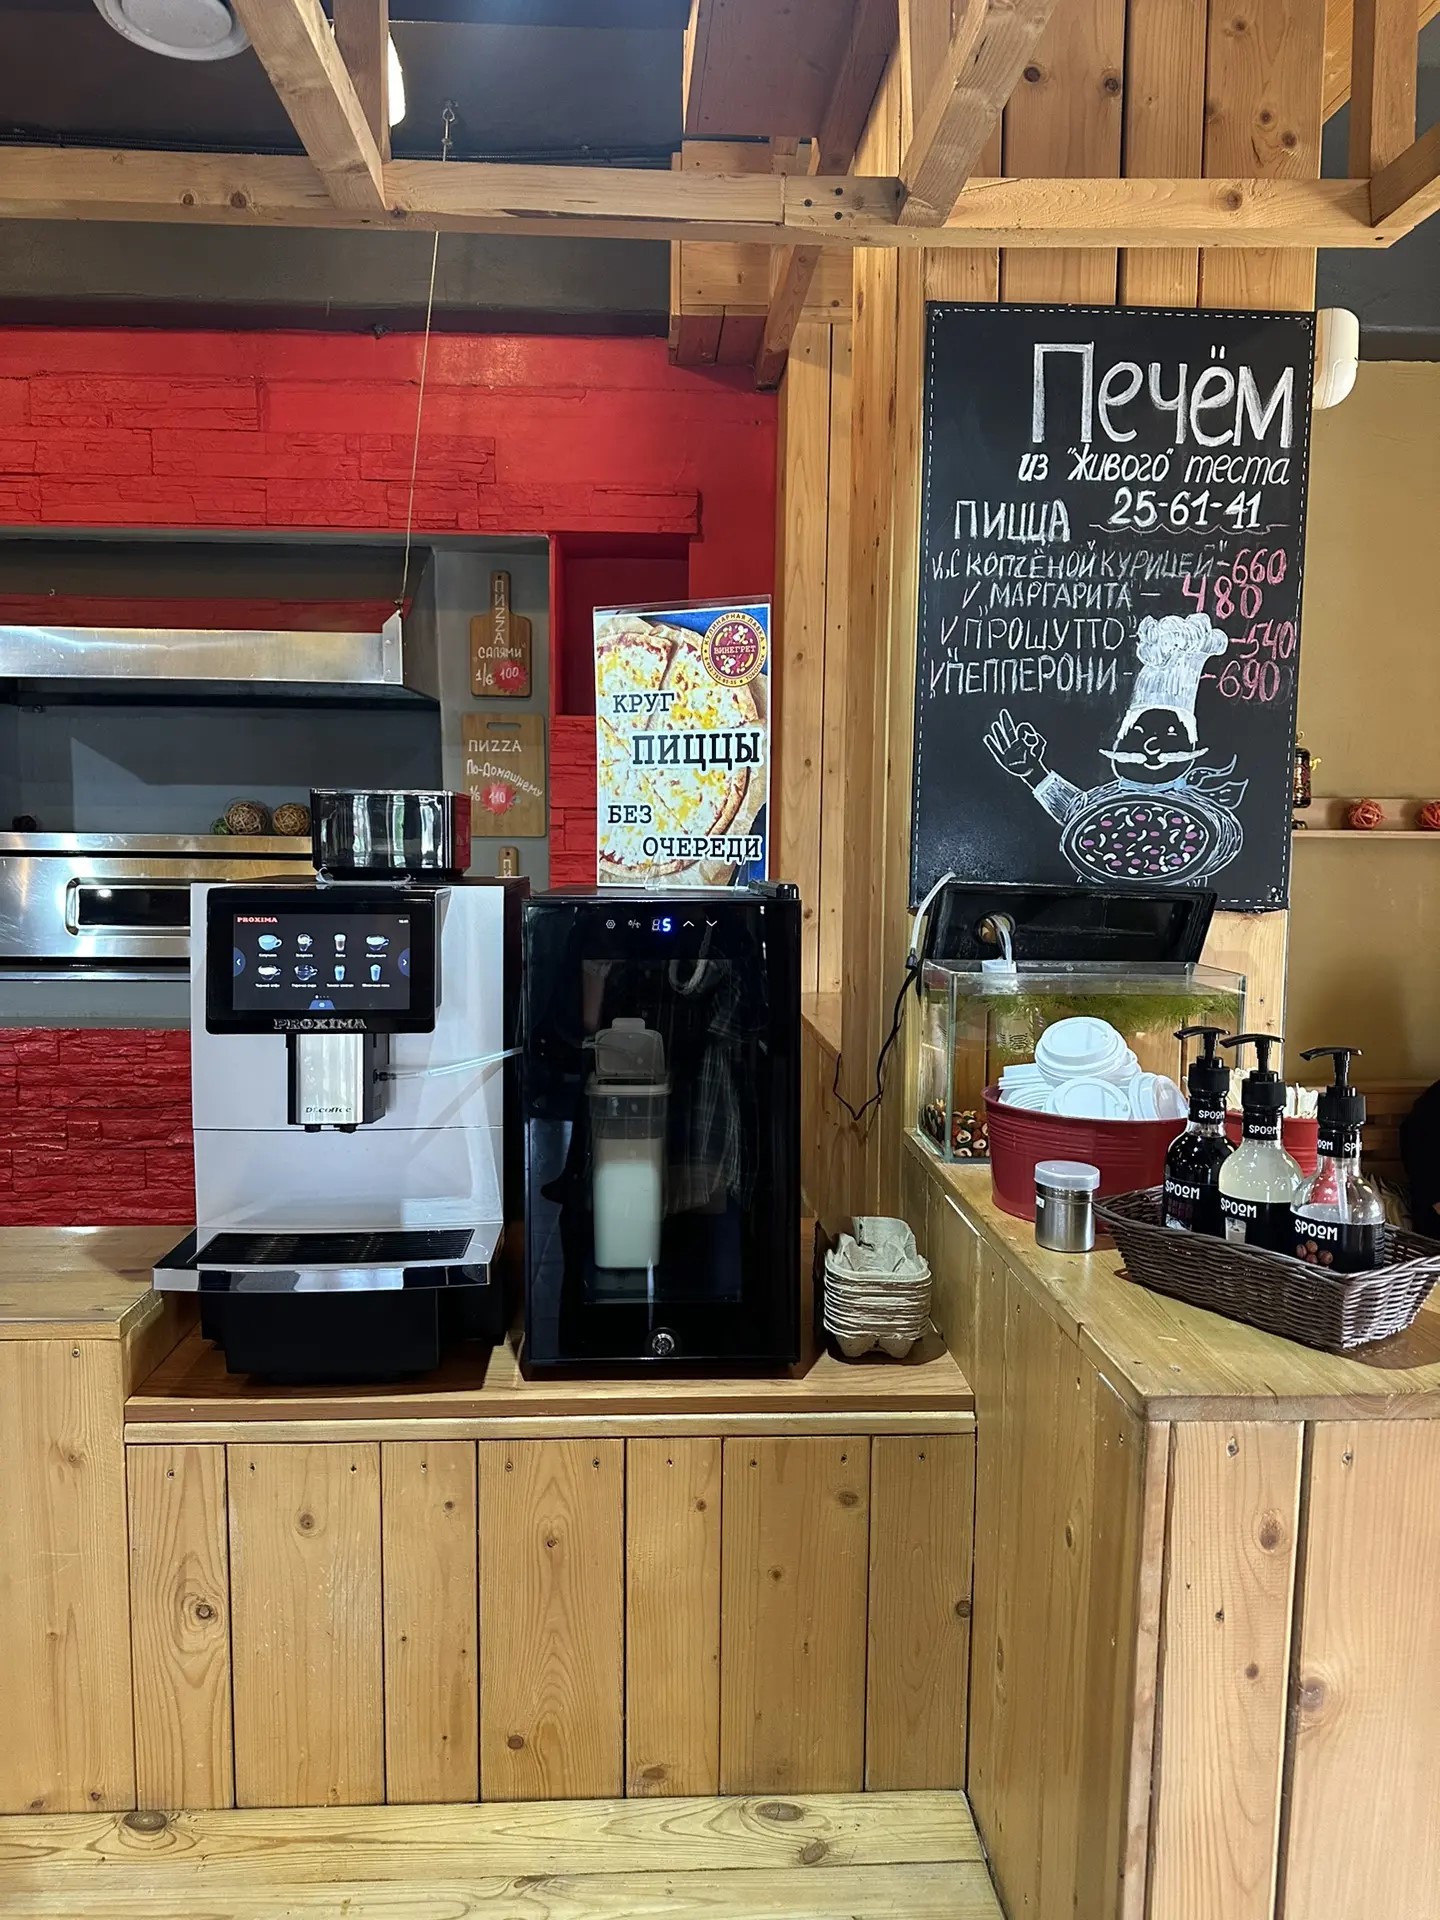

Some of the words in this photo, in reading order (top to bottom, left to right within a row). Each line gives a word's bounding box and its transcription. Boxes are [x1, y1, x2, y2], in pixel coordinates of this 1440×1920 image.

[1032, 341, 1293, 448] Печём
[1018, 453, 1048, 482] из
[1184, 453, 1291, 486] теста
[1107, 486, 1262, 529] 25-61-41
[954, 498, 1071, 547] ПИЦЦА
[1182, 574, 1263, 620] 480
[713, 645, 756, 655] ВИНЕГРЕТ
[475, 662, 494, 687] 1/6
[499, 666, 519, 681] 100
[612, 693, 675, 713] КРУГ
[632, 732, 761, 771] ПИЦЦЫ
[607, 805, 652, 824] БЕЗ
[642, 837, 760, 863] ОЧЕРЕДИ
[273, 1018, 367, 1030] PROXIMA
[1198, 1109, 1225, 1120] SPOOM
[1249, 1124, 1279, 1135] SPOOM
[1165, 1180, 1200, 1200] SPOOM
[1220, 1197, 1257, 1218] SPOOM
[1294, 1218, 1338, 1241] SPOOM
